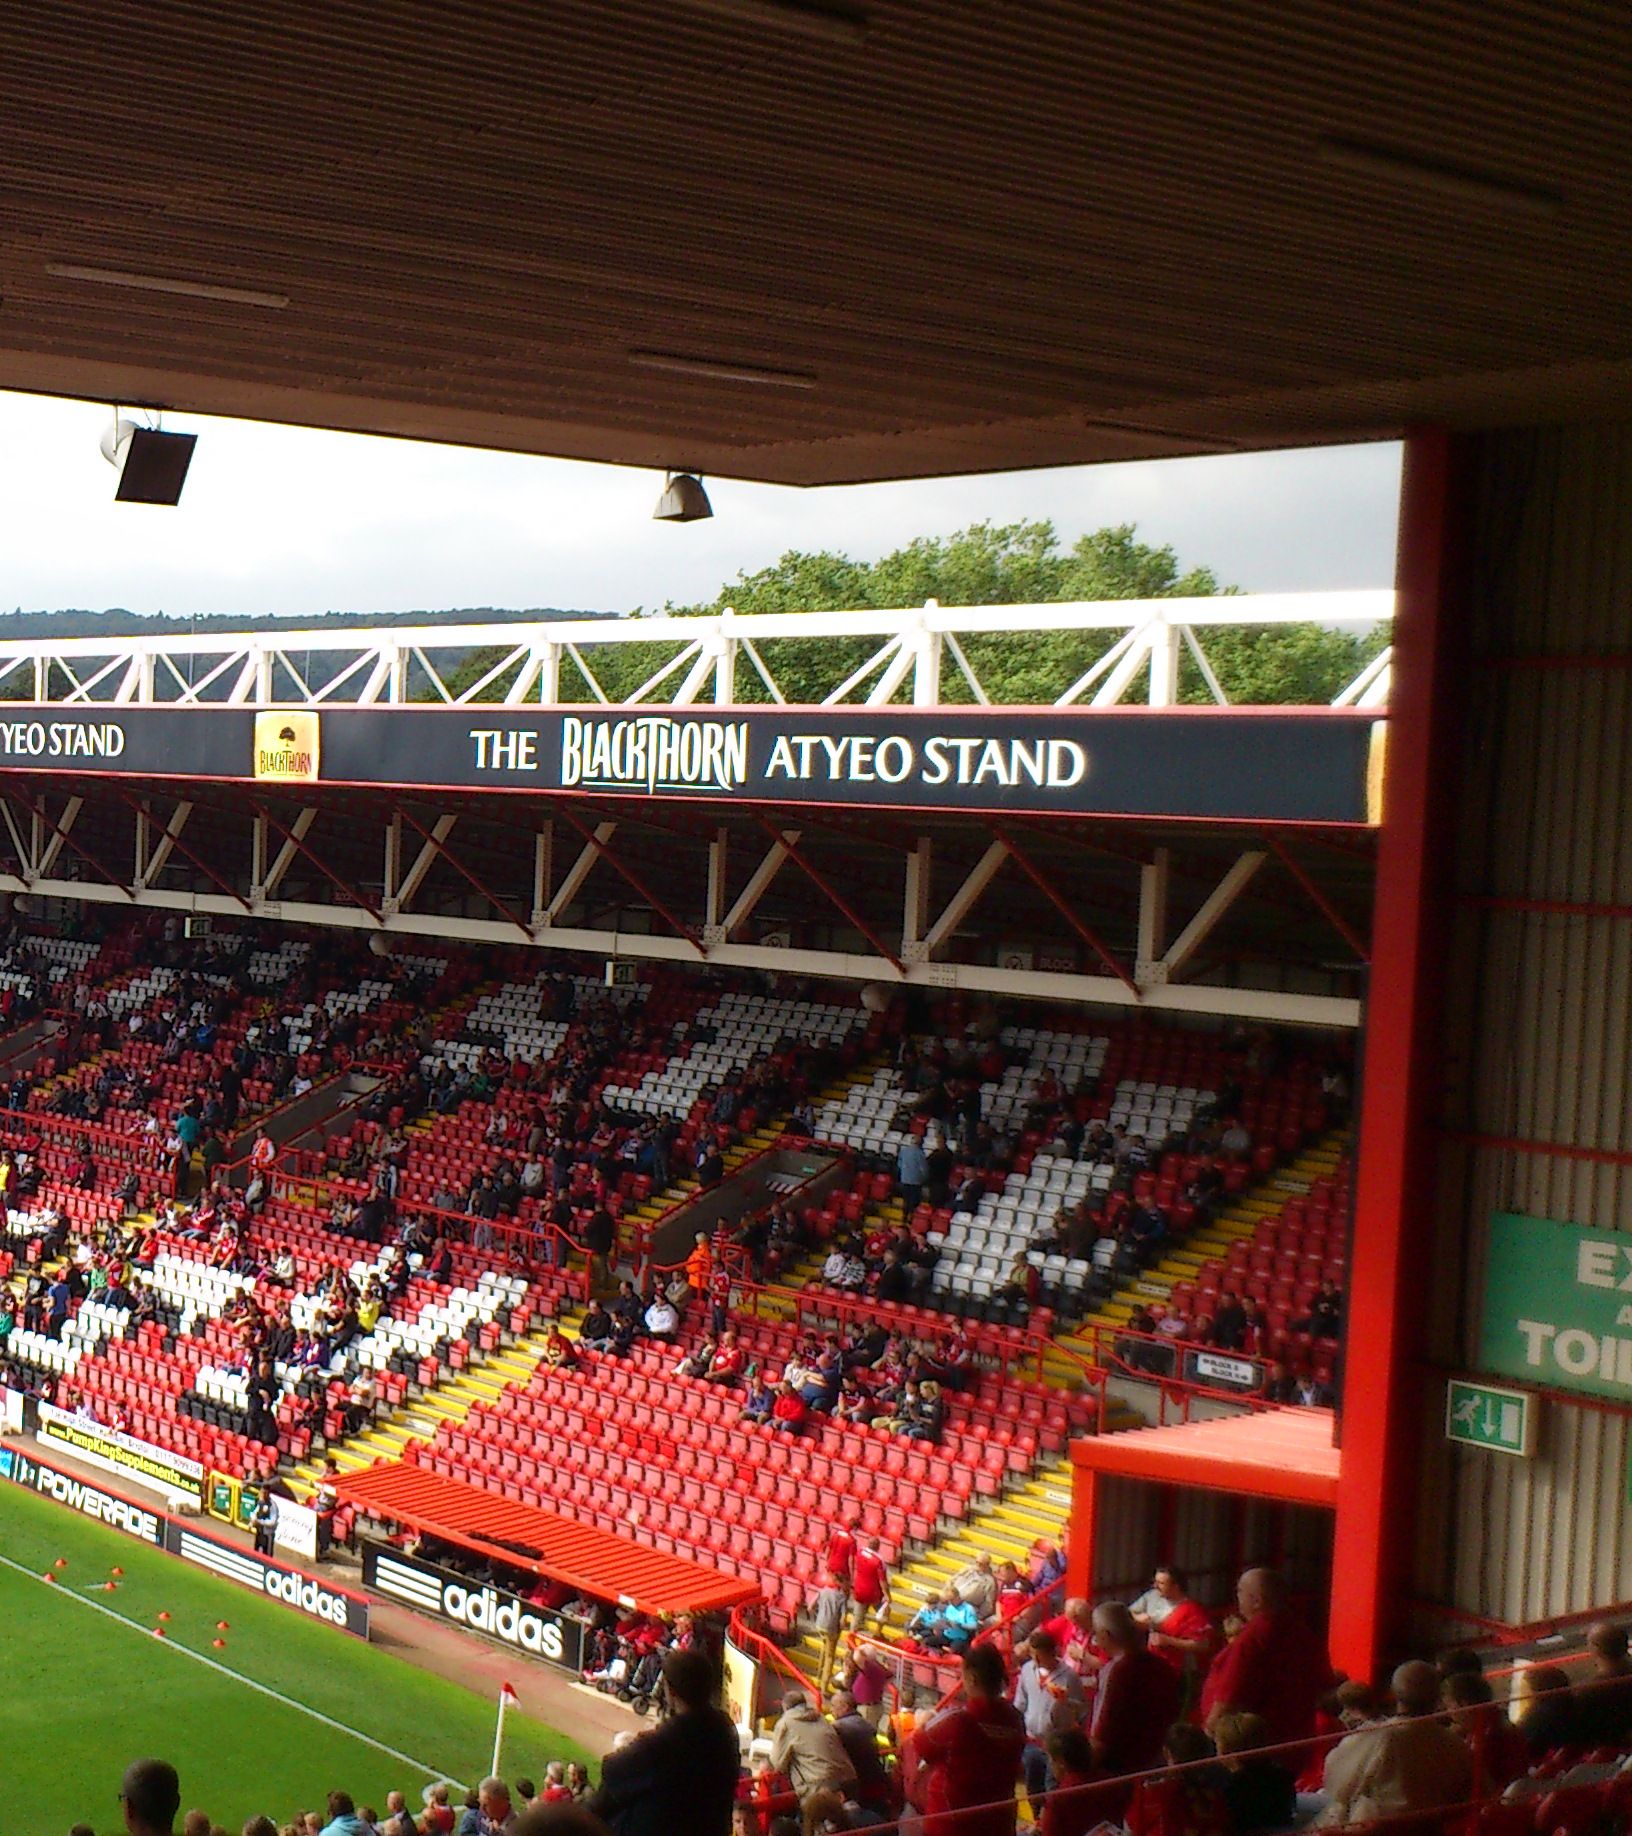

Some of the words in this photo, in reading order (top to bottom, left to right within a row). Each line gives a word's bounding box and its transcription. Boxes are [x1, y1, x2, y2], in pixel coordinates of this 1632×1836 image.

[49, 723, 125, 757] STAND
[259, 750, 312, 775] BLACKTHORN
[470, 730, 538, 770] THE
[561, 717, 747, 794] BLACKTHORN
[765, 735, 913, 782] ATYEO
[922, 736, 1086, 788] STAND
[37, 1466, 158, 1543] POWERADE
[265, 1569, 347, 1626] adidas
[444, 1585, 563, 1658] adidas
